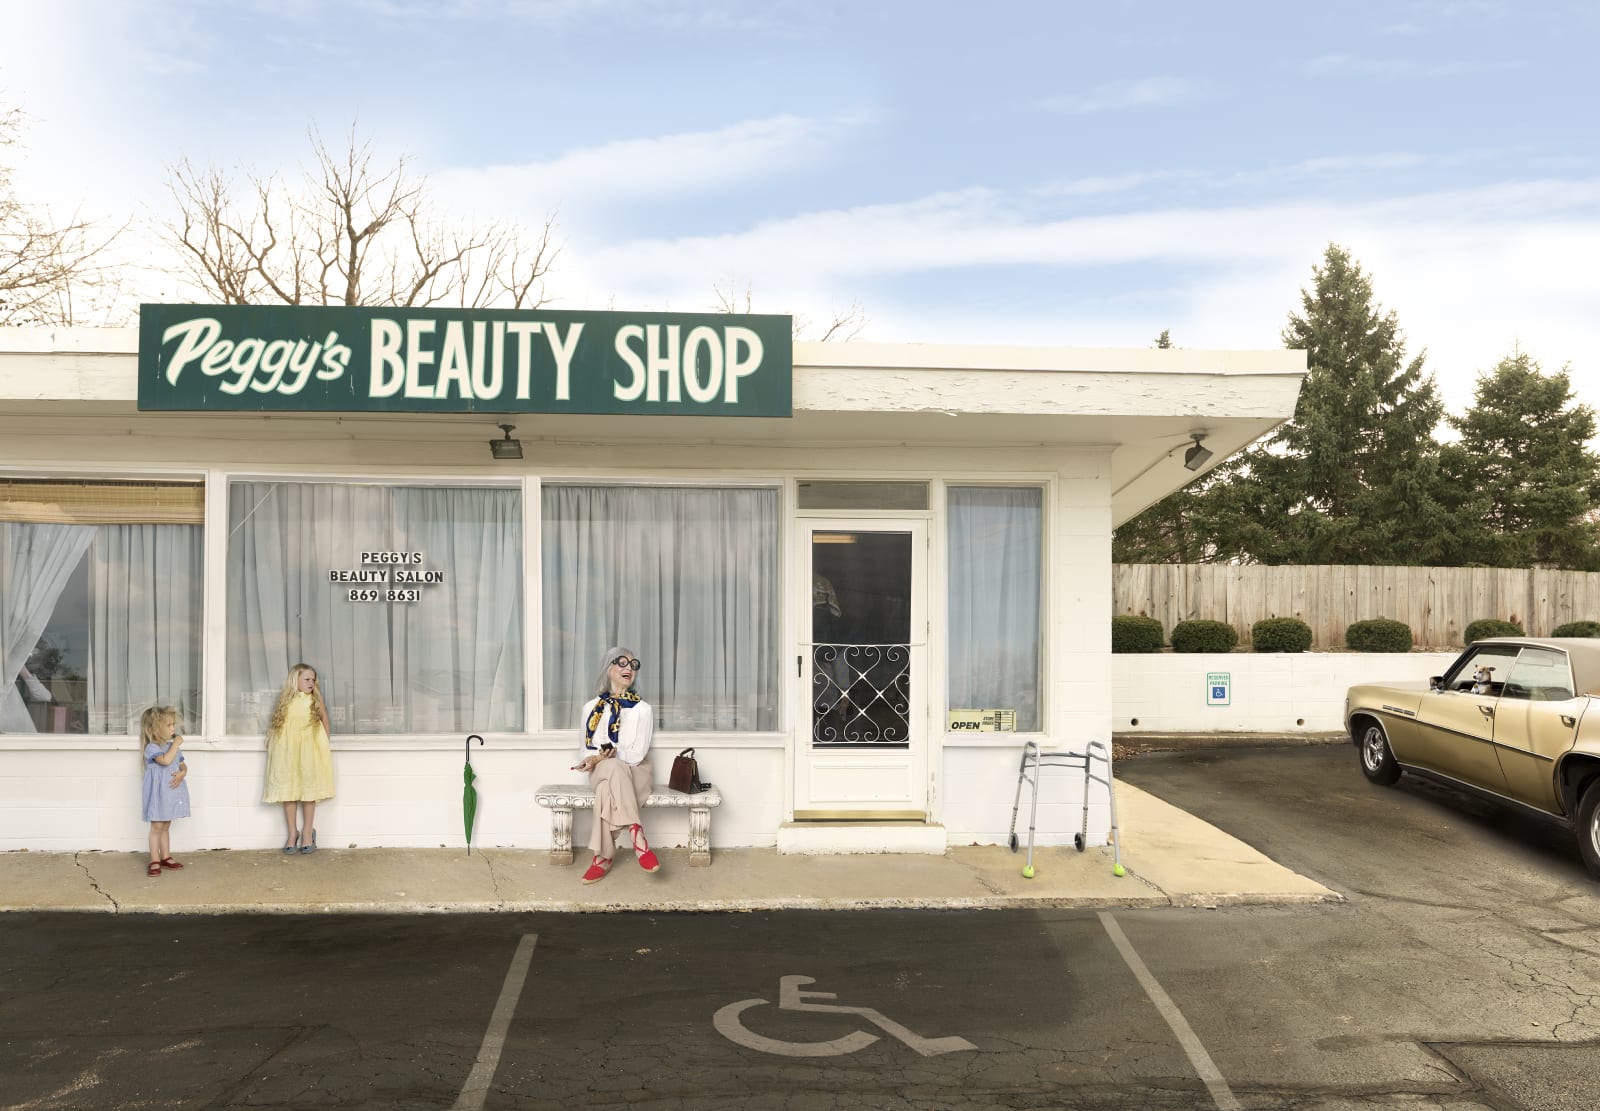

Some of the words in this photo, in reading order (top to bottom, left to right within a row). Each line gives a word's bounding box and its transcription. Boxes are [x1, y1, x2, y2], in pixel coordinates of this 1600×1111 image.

[162, 317, 352, 395] Peggy's
[368, 317, 586, 400] BEAUTY
[613, 323, 764, 403] SHOP
[330, 570, 387, 582] BEAUTY
[396, 571, 444, 583] SALON
[350, 590, 378, 601] 869
[387, 590, 420, 601] 8631
[951, 721, 981, 730] OPEN
